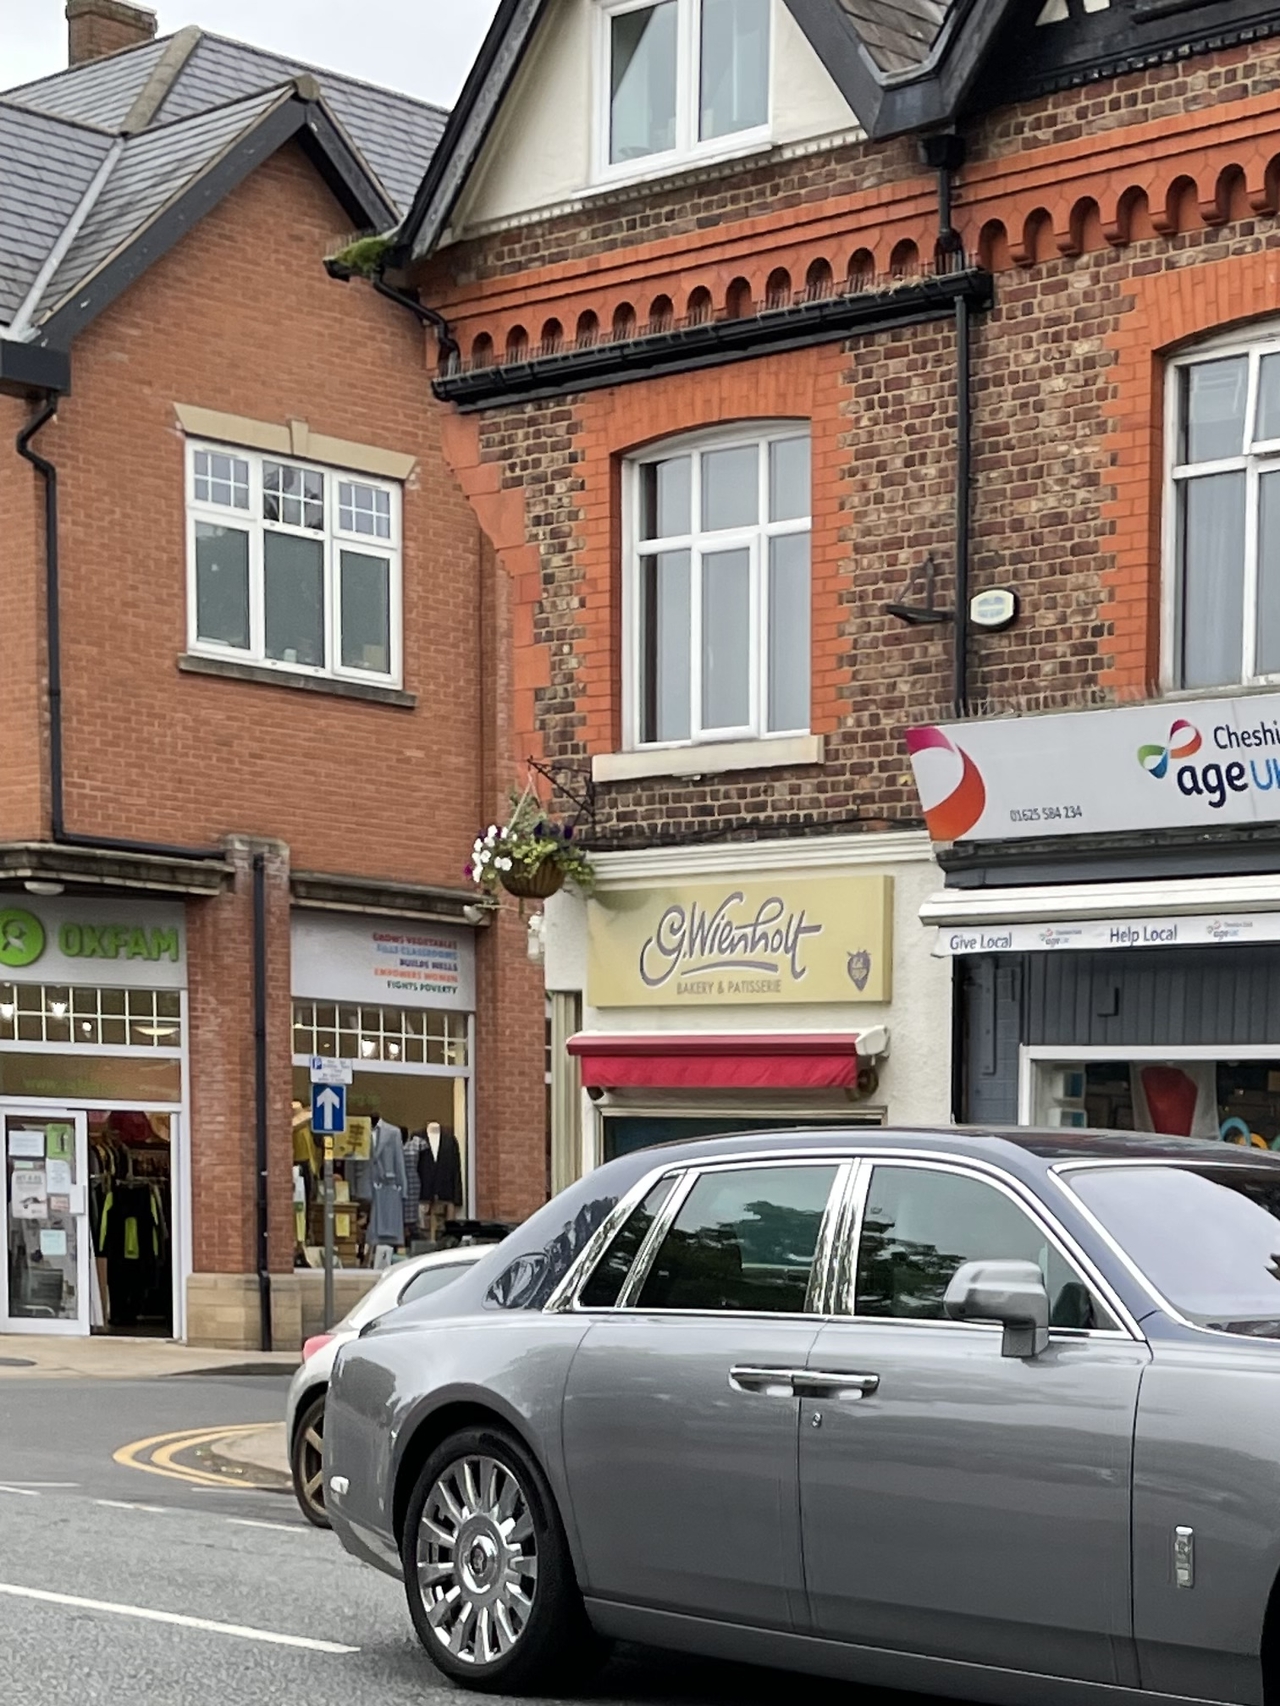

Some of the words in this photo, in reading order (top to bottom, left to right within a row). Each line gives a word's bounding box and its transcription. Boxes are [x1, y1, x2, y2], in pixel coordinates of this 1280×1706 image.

[1009, 808, 1041, 822] 01625
[1043, 806, 1061, 821] 584
[1063, 805, 1083, 819] 234
[58, 922, 180, 963] OXFAM
[950, 934, 977, 950] Give
[980, 932, 1012, 949] Local
[1110, 926, 1140, 946] Help
[1143, 925, 1178, 942] Local
[387, 980, 418, 991] FIGHTS
[420, 983, 458, 994] POVERTY
[677, 982, 715, 996] BAKERY
[717, 981, 725, 994] &
[727, 980, 782, 994] PATISSERIE
